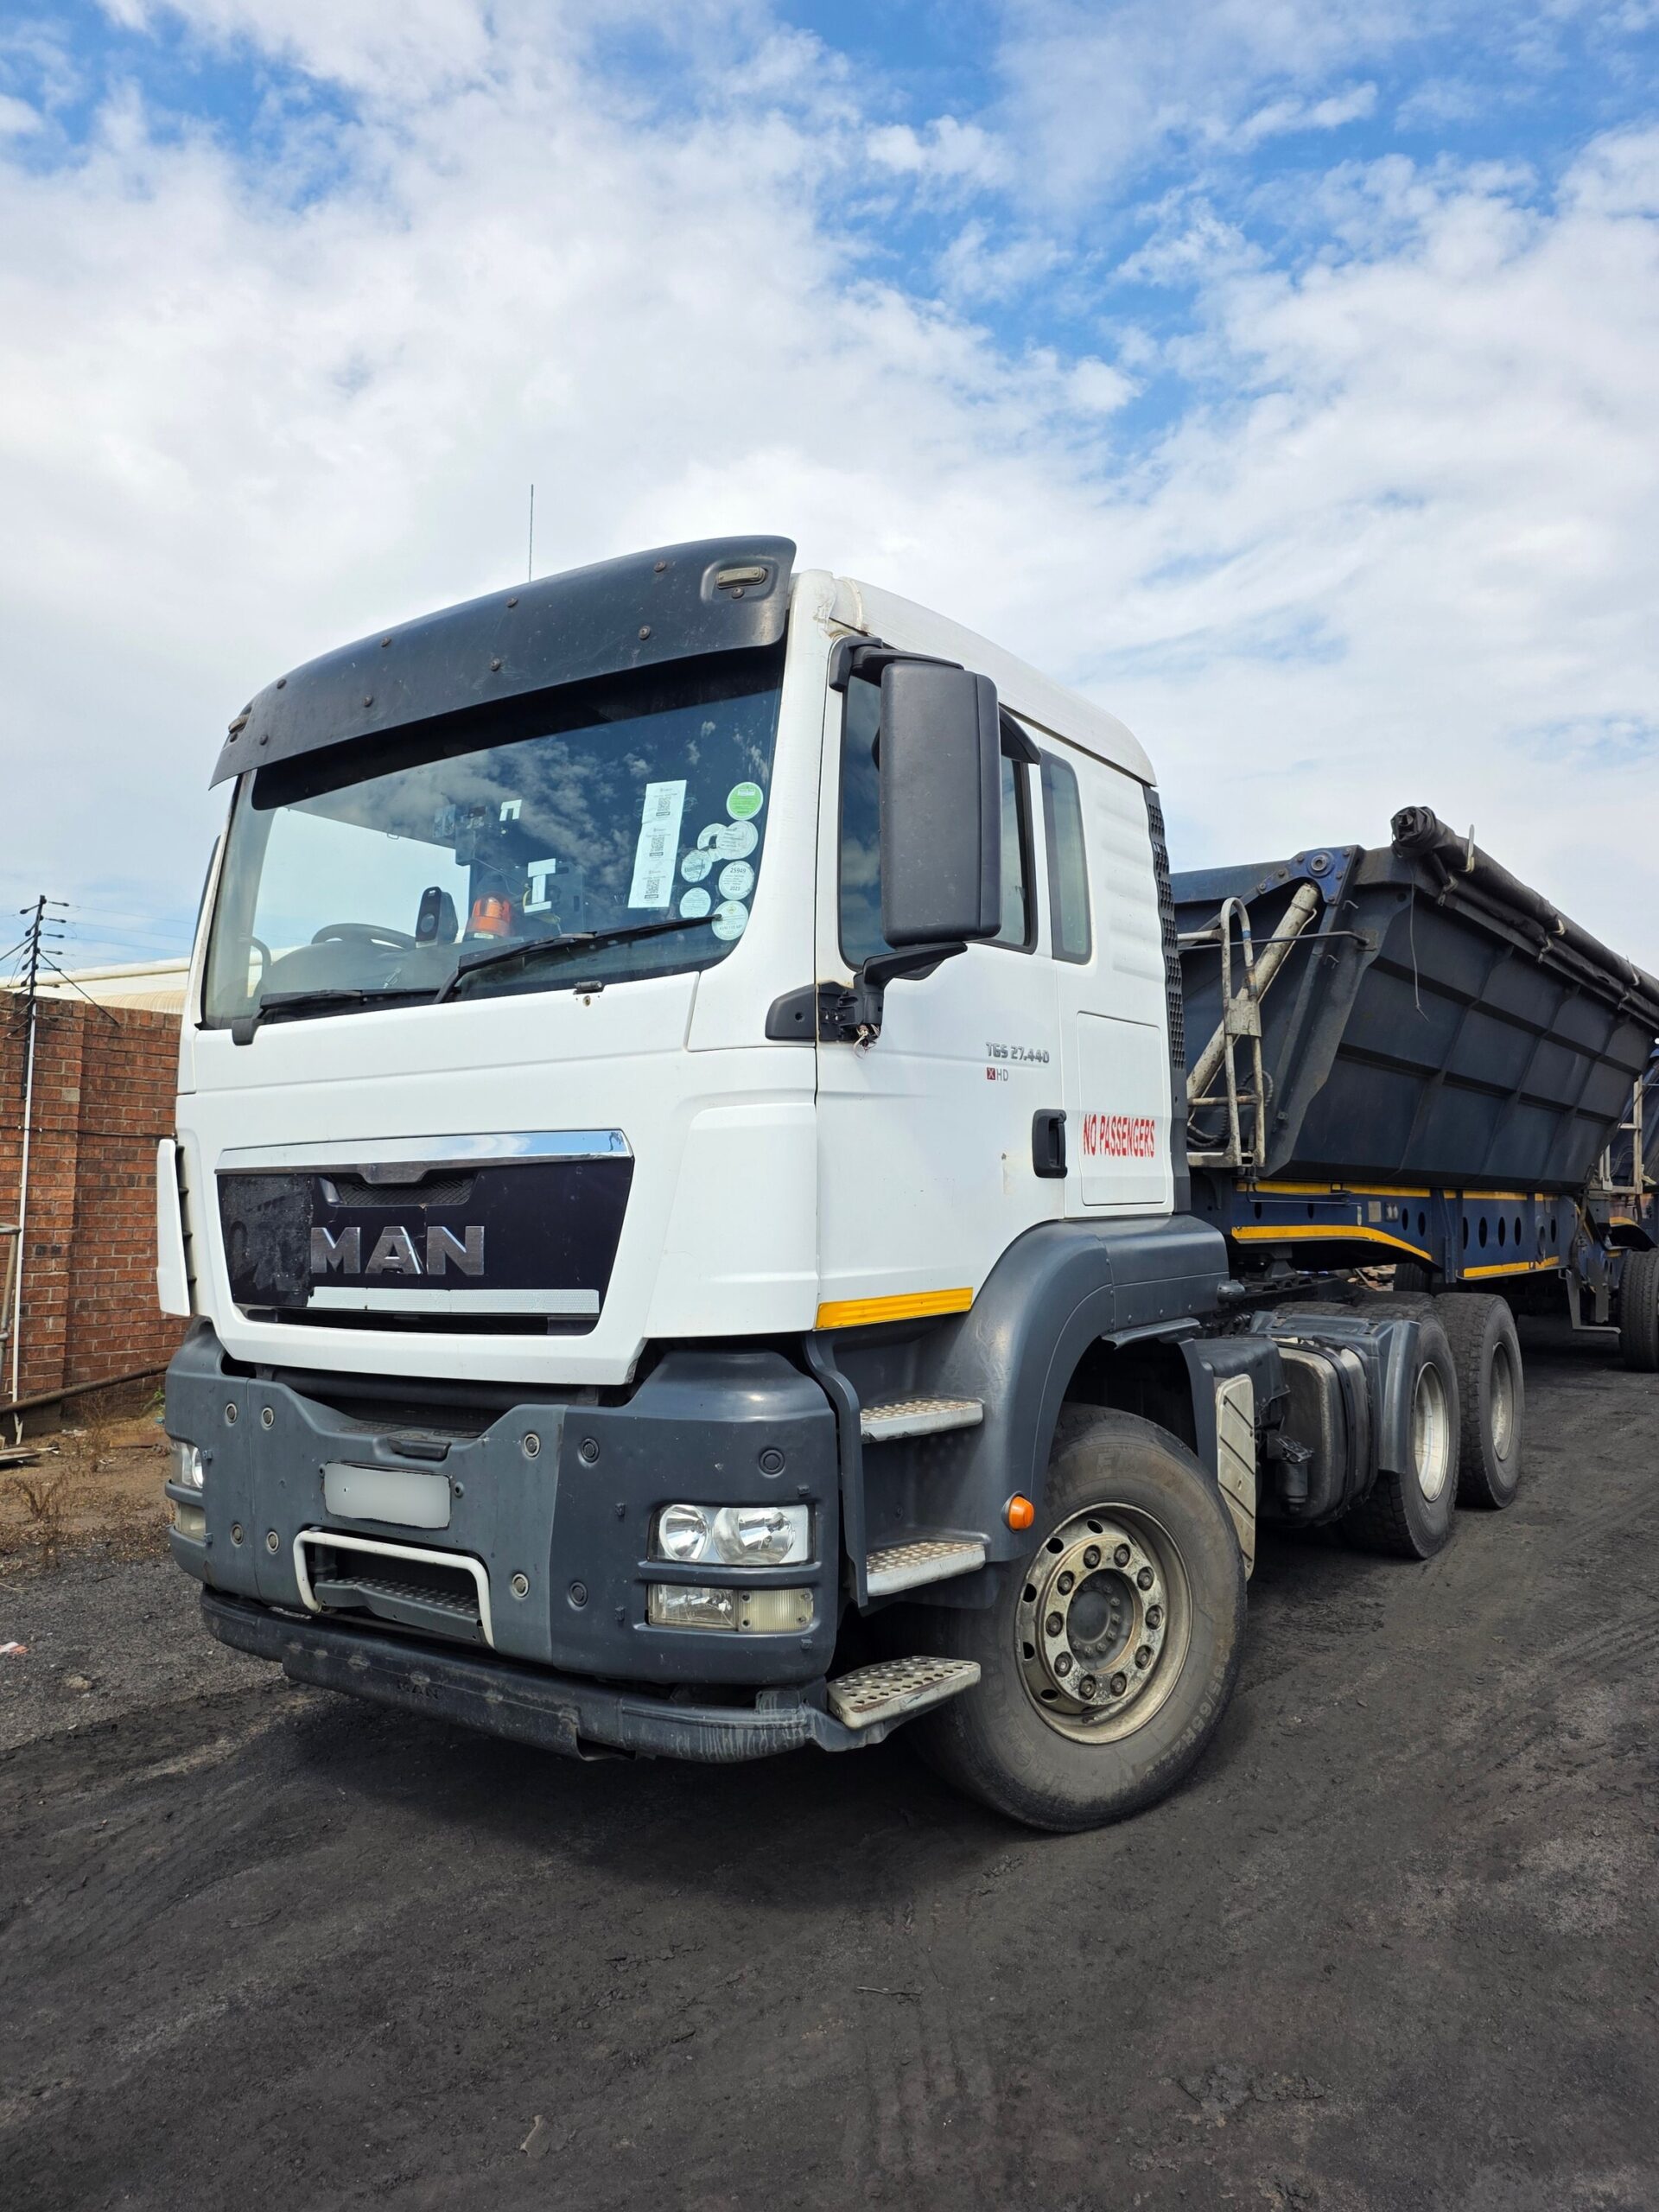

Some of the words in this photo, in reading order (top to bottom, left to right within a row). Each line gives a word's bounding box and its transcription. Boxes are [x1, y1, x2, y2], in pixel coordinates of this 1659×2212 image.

[986, 1041, 1008, 1058] TGS
[1010, 1046, 1050, 1064] 27.440
[1084, 1114, 1096, 1156] NO
[1099, 1115, 1154, 1158] PASSENGERS
[311, 1225, 485, 1275] MAN
